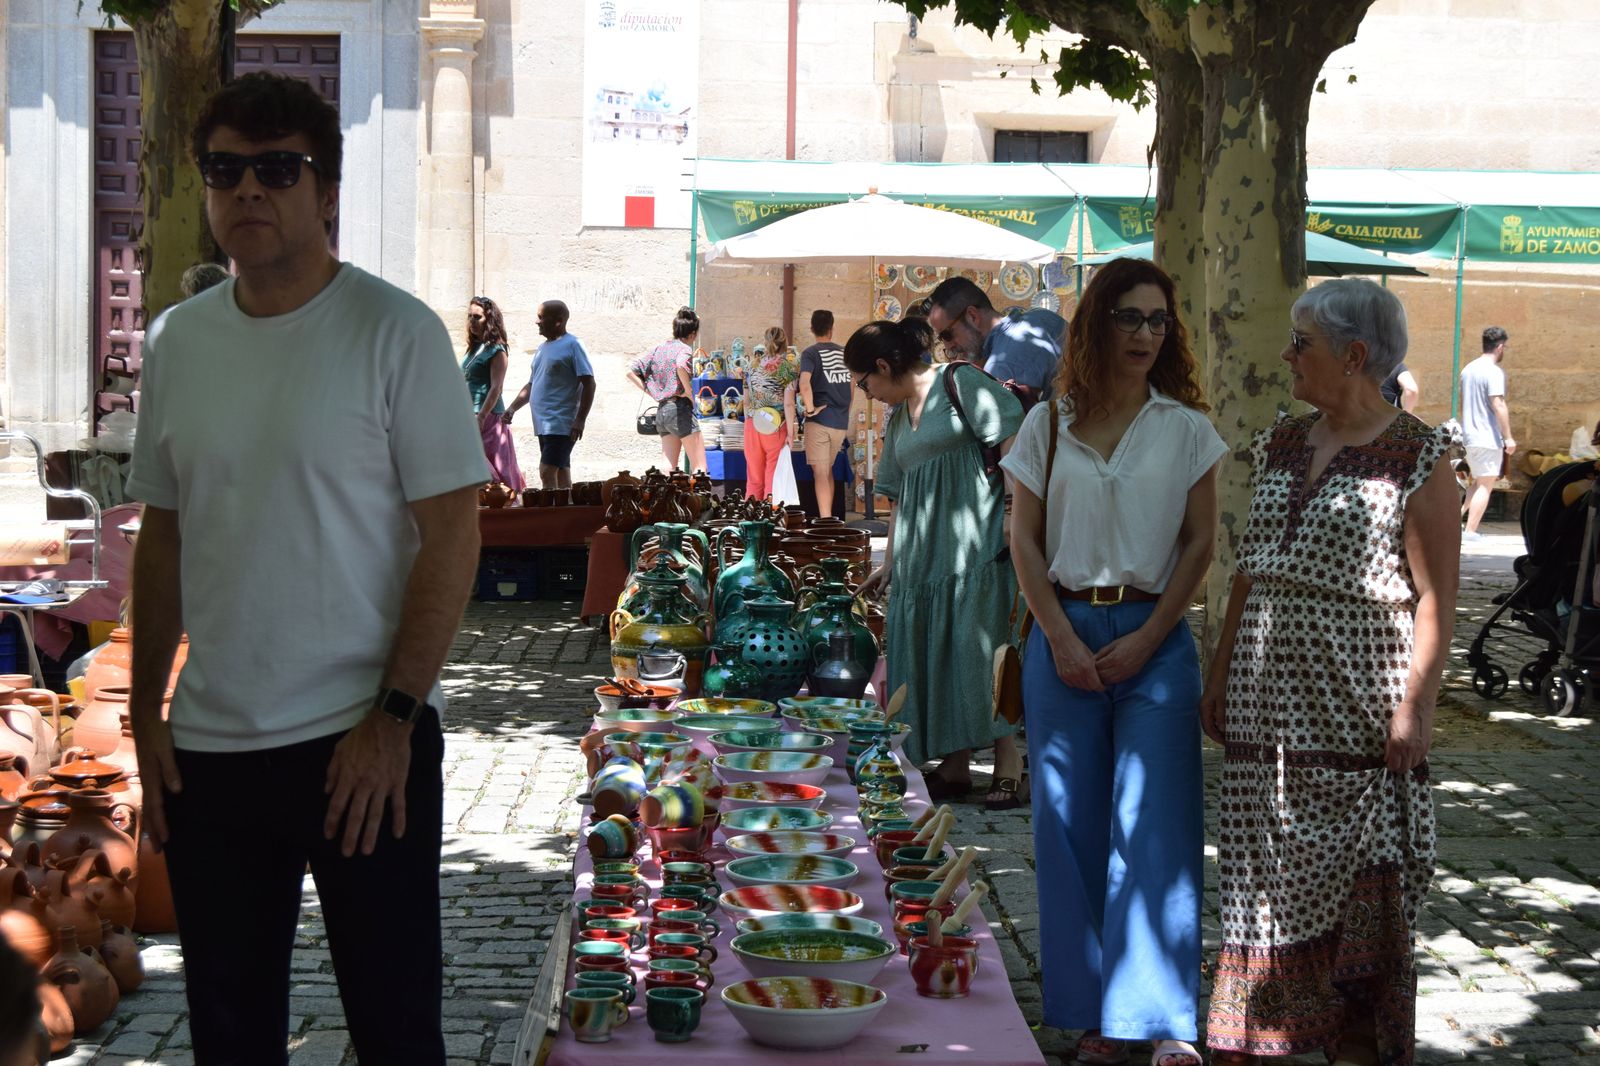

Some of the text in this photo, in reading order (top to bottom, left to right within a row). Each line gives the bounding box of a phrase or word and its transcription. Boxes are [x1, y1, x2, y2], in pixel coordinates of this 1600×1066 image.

[634, 24, 676, 32] ZAMORA
[1335, 224, 1371, 238] CAJA
[1371, 226, 1422, 239] RURAL
[1527, 239, 1547, 253] DE
[823, 369, 851, 383] VANS
